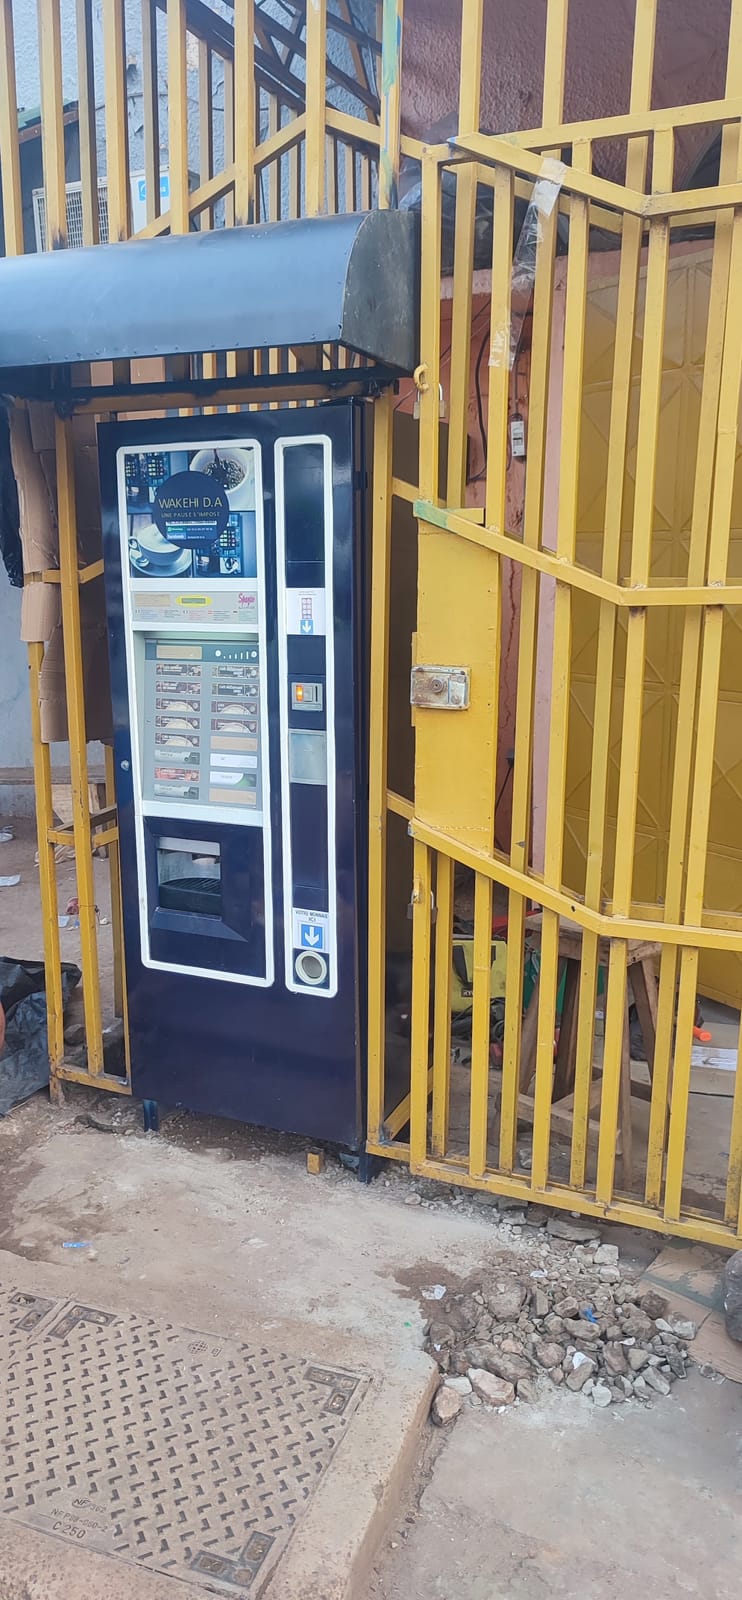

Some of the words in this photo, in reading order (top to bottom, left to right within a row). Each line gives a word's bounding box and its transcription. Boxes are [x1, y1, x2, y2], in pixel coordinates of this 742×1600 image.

[158, 497, 199, 509] WAKEHI
[203, 496, 223, 508] D.A
[52, 1521, 62, 1531] C
[62, 1524, 86, 1539] 250
